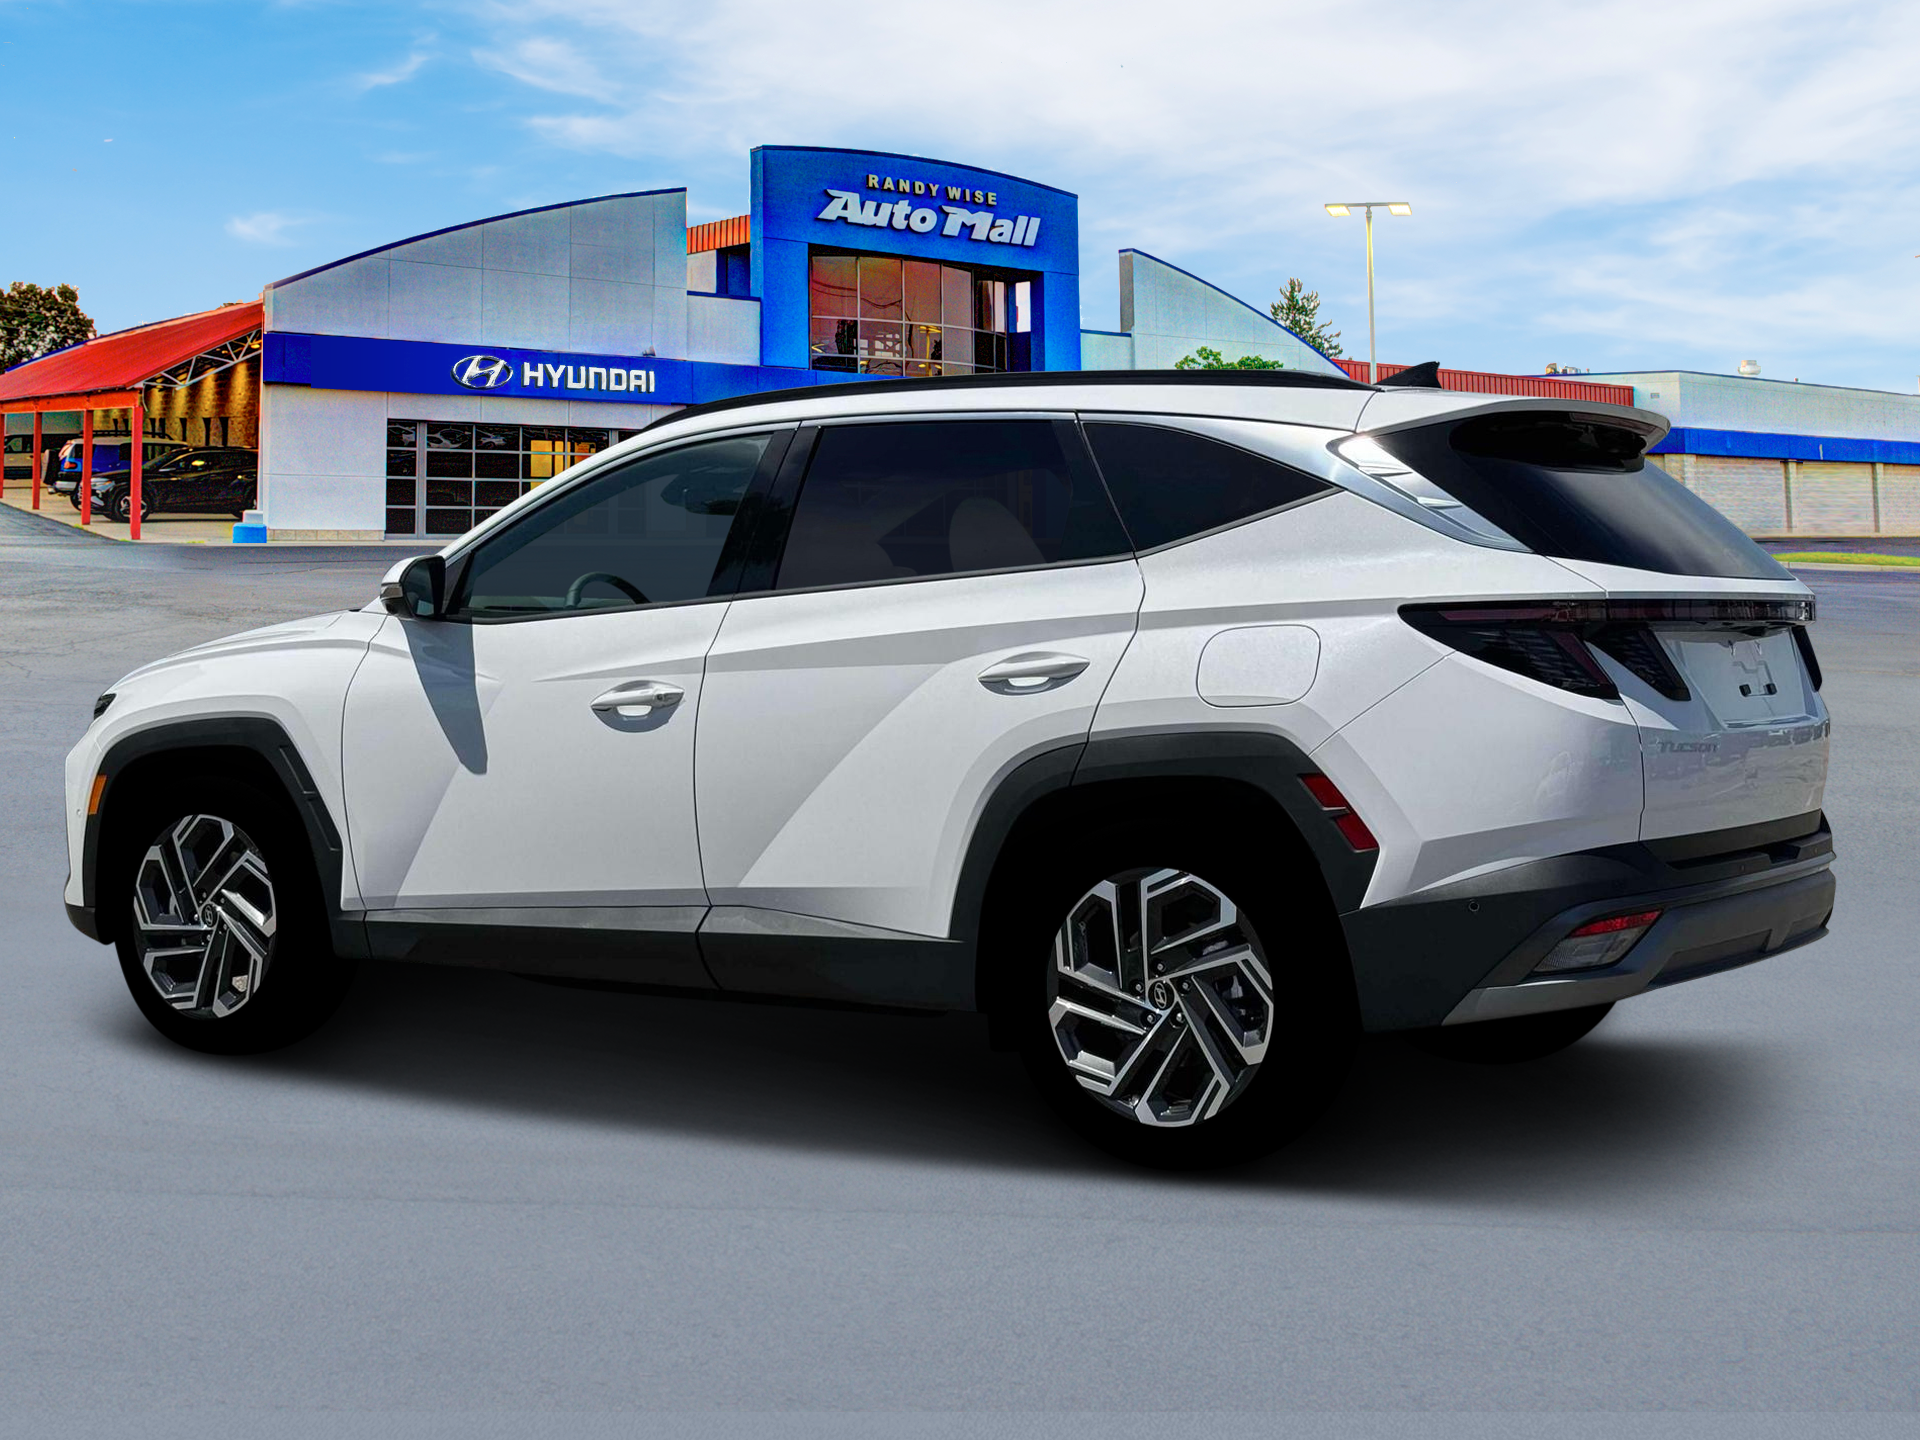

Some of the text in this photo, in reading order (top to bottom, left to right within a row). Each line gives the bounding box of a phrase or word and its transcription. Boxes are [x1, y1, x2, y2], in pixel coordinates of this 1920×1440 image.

[867, 174, 997, 205] RANDY WISE
[817, 188, 1041, 246] Auto Mall
[522, 362, 655, 393] HYUNDAI
